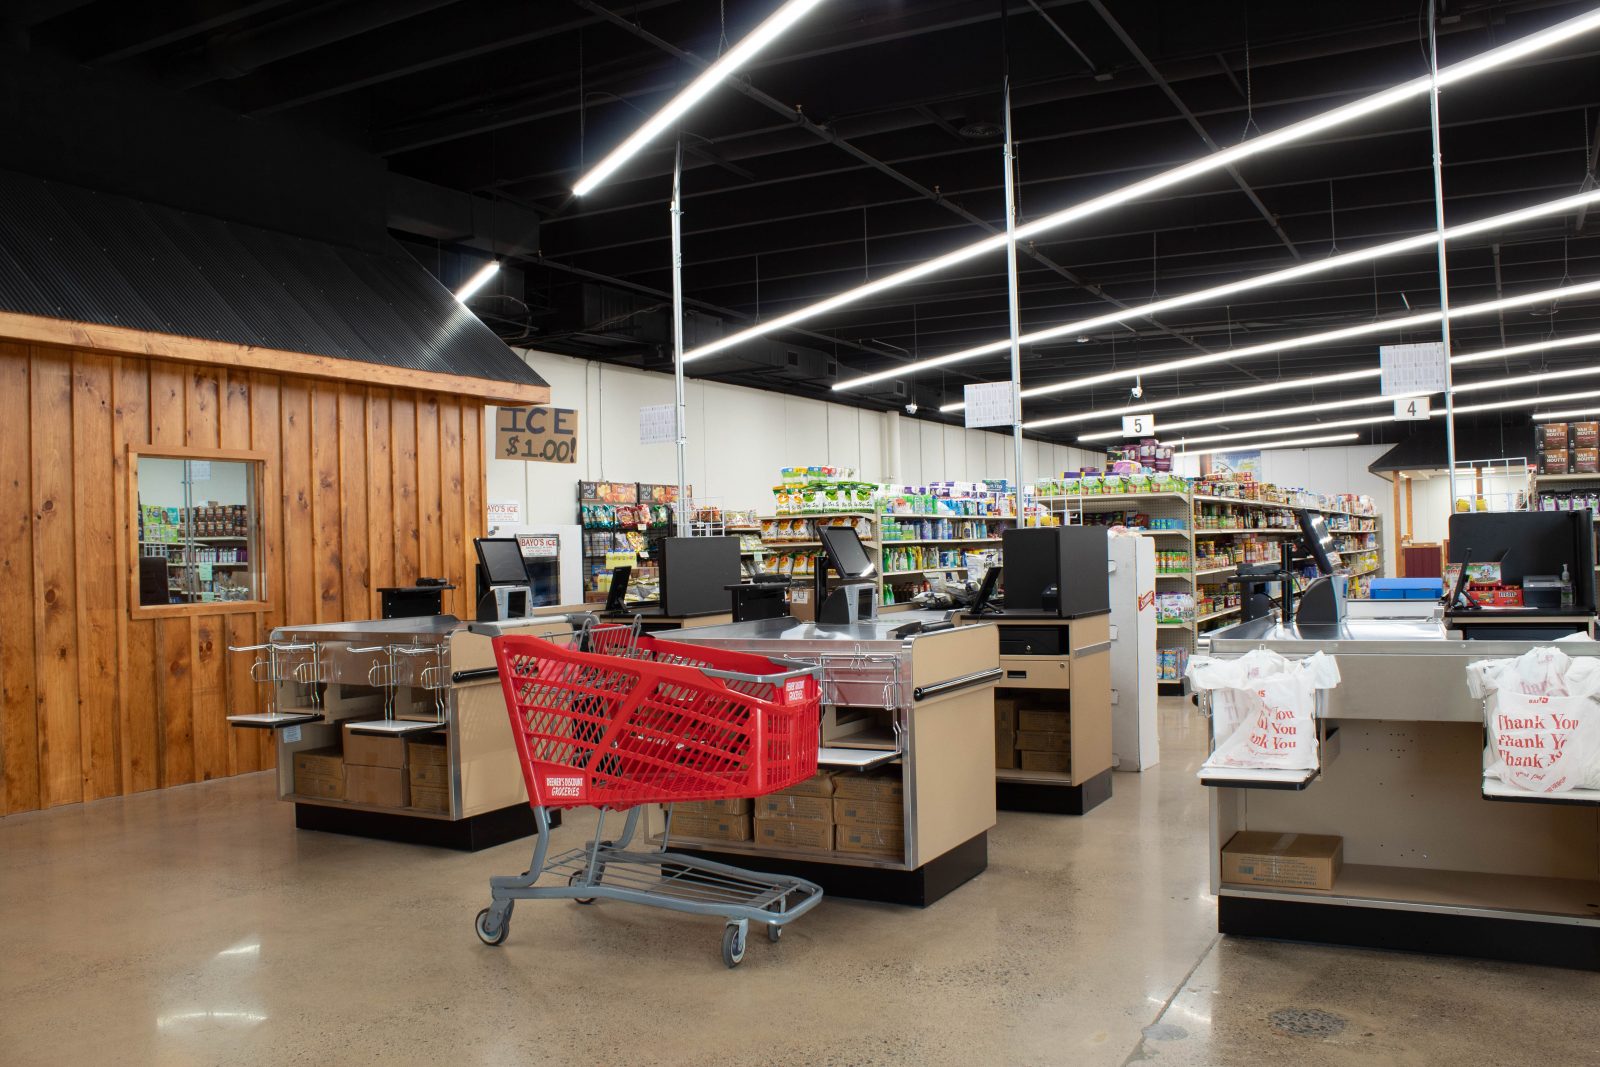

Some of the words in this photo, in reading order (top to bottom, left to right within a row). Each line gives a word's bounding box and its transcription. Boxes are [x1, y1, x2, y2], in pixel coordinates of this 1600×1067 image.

[1407, 400, 1416, 416] 4
[500, 407, 574, 435] ICE
[1134, 418, 1142, 433] 5
[505, 435, 576, 463] $1.00!
[487, 504, 506, 513] AYO'S
[507, 505, 518, 513] ICE
[521, 538, 545, 547] BAYO'S
[546, 538, 557, 547] ICE
[1272, 722, 1297, 736] You
[1499, 713, 1546, 731] Thank
[1273, 736, 1297, 750] You
[564, 777, 583, 786] DISCOUNT
[551, 786, 580, 797] GROCERIES
